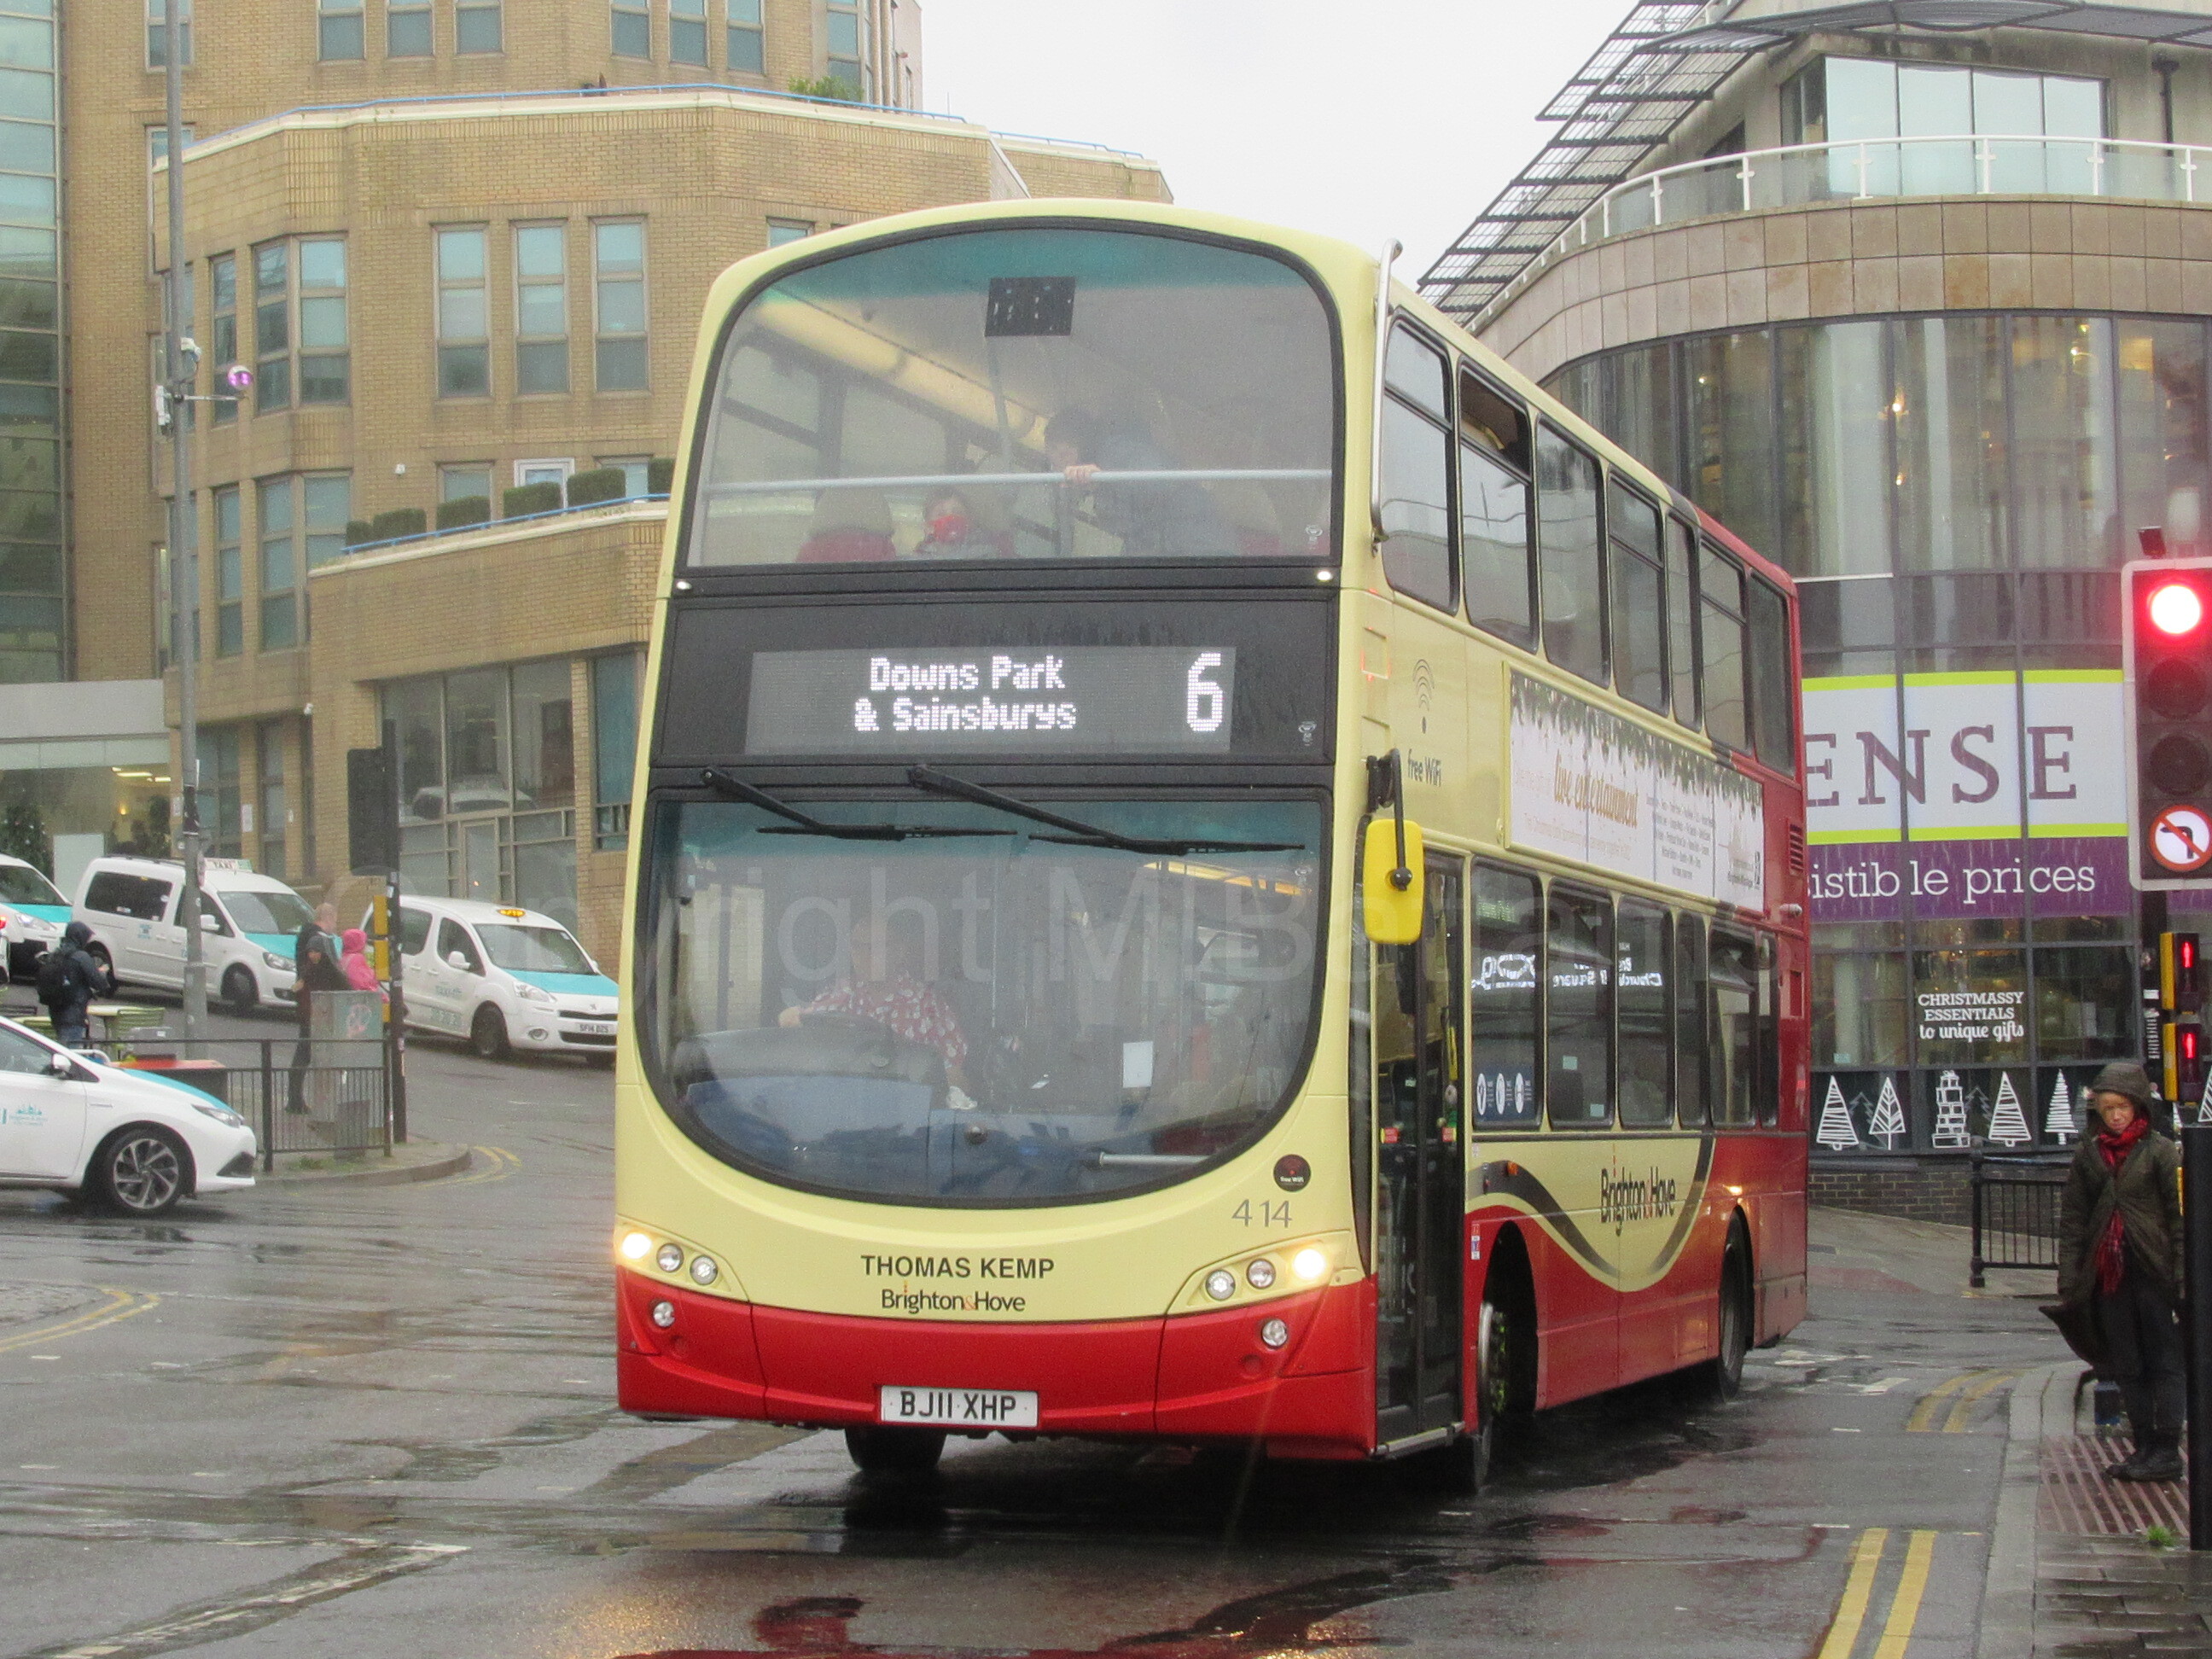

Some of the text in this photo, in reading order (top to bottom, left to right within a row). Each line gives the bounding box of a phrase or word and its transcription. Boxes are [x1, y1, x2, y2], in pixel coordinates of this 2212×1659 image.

[870, 655, 1066, 691] Downs Park
[1185, 652, 1224, 732] 6
[853, 696, 1077, 731] & Sainsburys
[1407, 748, 1423, 782] free
[1962, 857, 2096, 905] prices
[1917, 991, 2025, 1006] CHRISTMASSY
[1924, 1006, 2015, 1022] ESSENTIALS
[1919, 1020, 2025, 1043] to unique gifts
[1231, 1198, 1294, 1228] 414
[860, 1254, 1055, 1278] THOMAS KEMP
[899, 1390, 1017, 1422] BJ11 XHP
